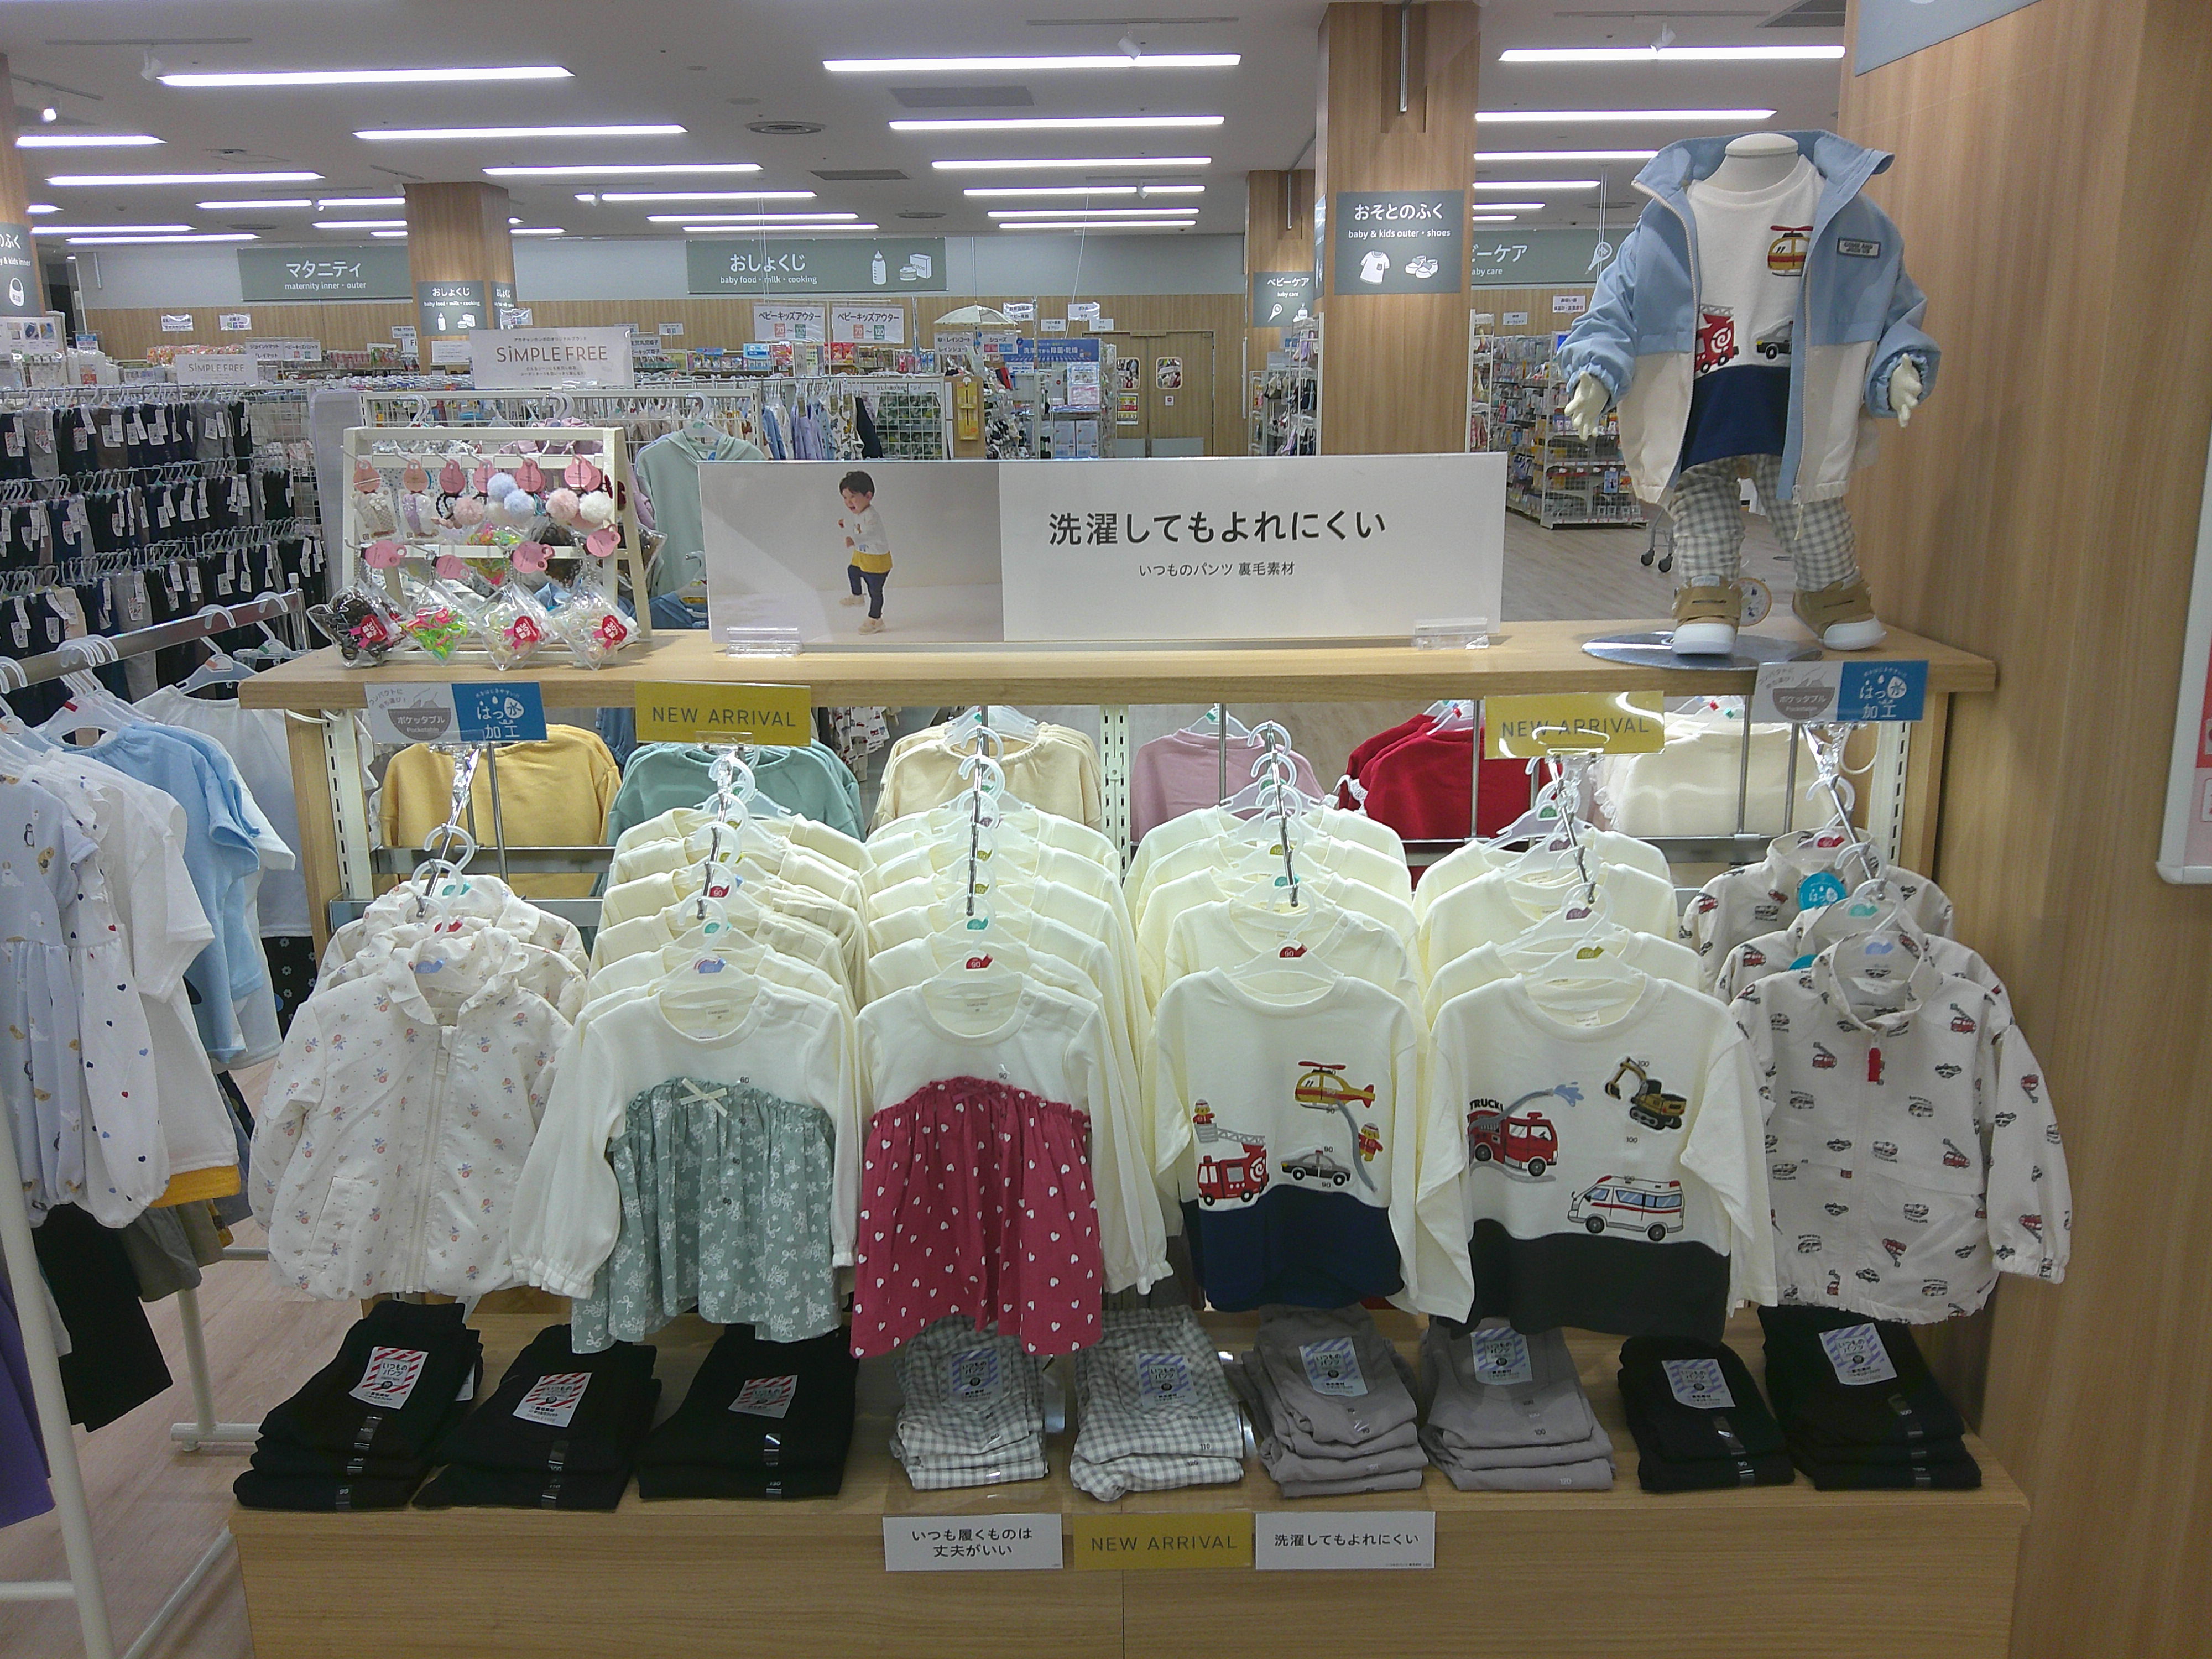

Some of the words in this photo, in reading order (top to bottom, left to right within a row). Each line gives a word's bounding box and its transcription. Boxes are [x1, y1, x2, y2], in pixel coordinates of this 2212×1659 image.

[1354, 203, 1443, 220] おそとのふく
[1348, 230, 1369, 240] baby
[1379, 229, 1395, 238] kids
[1427, 229, 1451, 237] shoes
[286, 260, 361, 278] マタニティ
[730, 253, 806, 272] おしょくじ
[285, 281, 319, 291] maternity
[720, 276, 738, 285] baby
[788, 275, 817, 285] cooking
[1267, 277, 1310, 288] ベビーケア
[432, 286, 470, 297] おしょくじ
[759, 311, 821, 321] ベビーキッズアウター
[837, 311, 900, 322] ベビーキッズアウター
[874, 328, 884, 336] 120
[566, 345, 608, 361] FREE
[223, 363, 244, 372] FREE
[1048, 508, 1387, 547] 洗濯してもよれにくい
[1139, 563, 1233, 578] いつものパンツ
[1238, 561, 1296, 577] 裏毛素材
[1778, 695, 1827, 703] ポケッタブル
[477, 700, 523, 720] はっ水
[653, 707, 700, 723] NEW
[708, 707, 797, 727] ARRIVAL
[1861, 704, 1897, 718] 加工
[398, 715, 445, 724] ポケッタブル
[485, 724, 520, 739] 加工
[1501, 721, 1550, 738] NEW
[1558, 717, 1650, 735] ARRIVAL
[382, 1363, 408, 1371] いつもの
[911, 1528, 1033, 1542] いつも履くものは
[1274, 1533, 1420, 1547] 洗濯してもよれにくい
[933, 1543, 1013, 1558] 丈夫がいい
[1091, 1537, 1138, 1552] NEW
[1147, 1535, 1238, 1551] ARRIVAL
